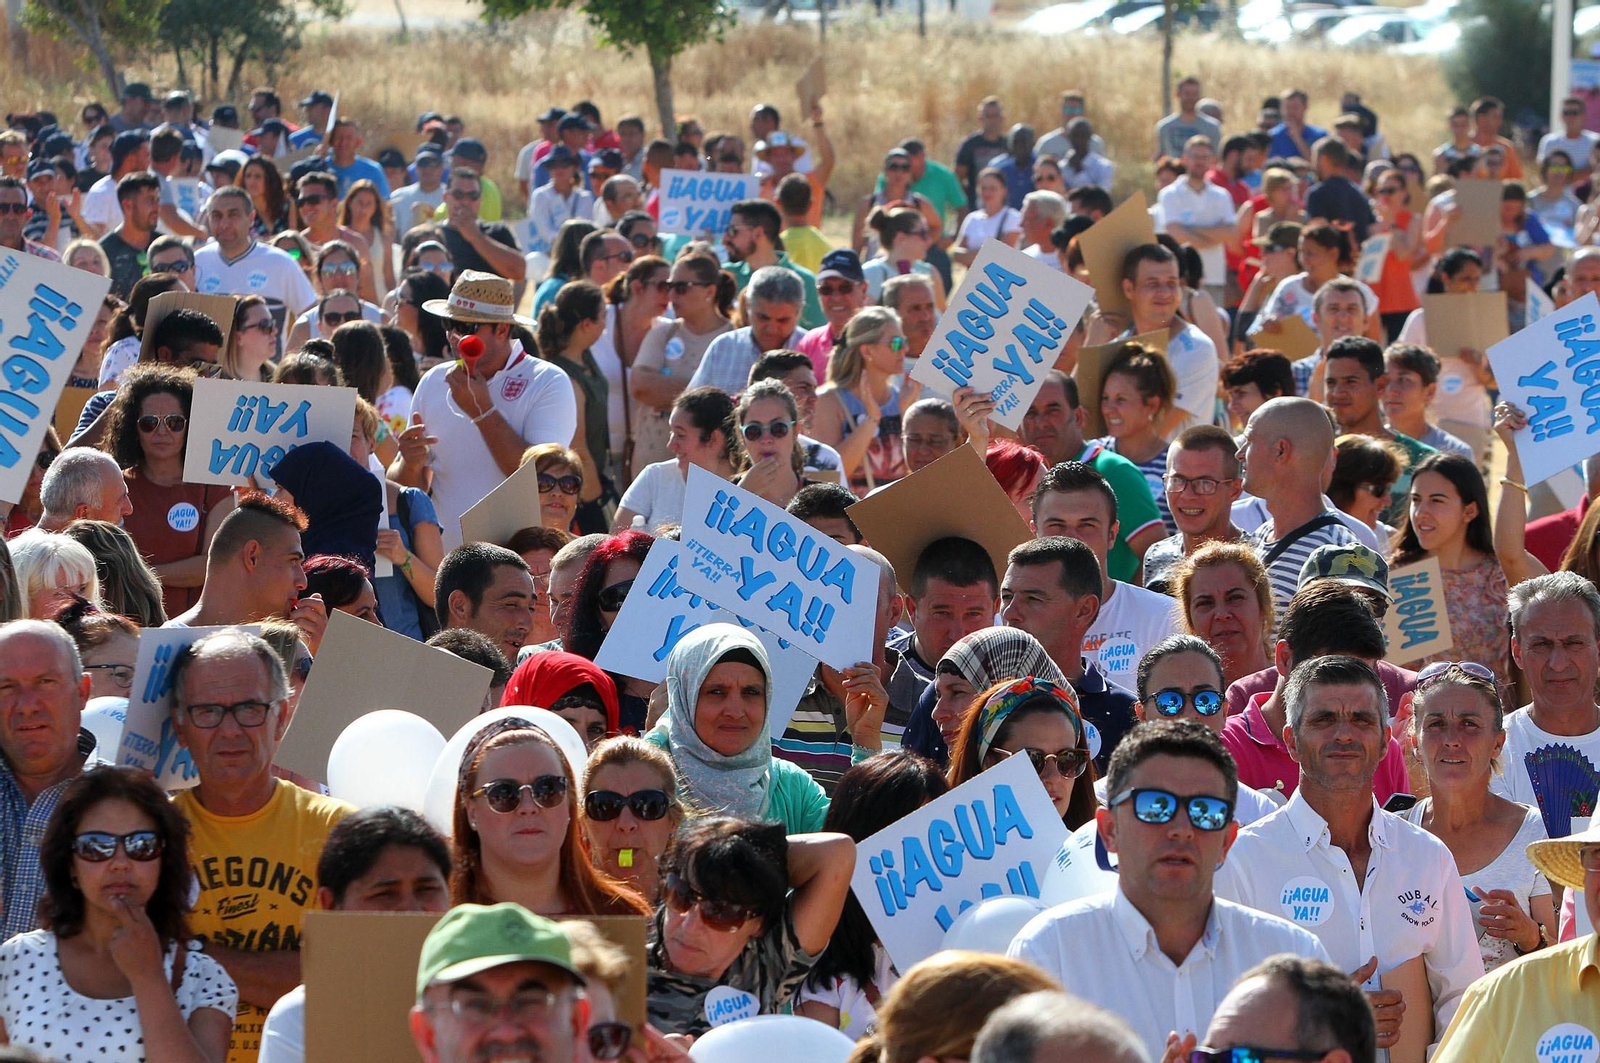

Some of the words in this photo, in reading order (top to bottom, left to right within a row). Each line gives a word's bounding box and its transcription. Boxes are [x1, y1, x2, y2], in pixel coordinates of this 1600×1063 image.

[931, 262, 1027, 387] ¡¡AGUA
[992, 298, 1067, 385] YA!!
[988, 374, 1018, 403] ERRA
[1554, 314, 1600, 435] ¡¡AG
[995, 393, 1021, 416] YA!!
[1517, 360, 1575, 442] YA!!
[227, 394, 312, 438] YA!!
[168, 508, 196, 521] ¡¡AGUA
[175, 518, 192, 528] YA!!
[685, 538, 743, 584] ¡¡TIERRA
[704, 489, 857, 605] ¡¡AGUA
[691, 557, 723, 585] YA!!
[736, 555, 836, 644] YA!!
[1389, 571, 1440, 650] ¡¡AGUA
[1099, 643, 1136, 661] ¡¡AGUA
[1108, 658, 1130, 672] YA!!
[869, 784, 1034, 916] ¡¡AGUA
[1282, 887, 1329, 905] ¡¡AGUA
[1397, 889, 1438, 909] DUBAI
[1293, 905, 1321, 922] YA!!
[1400, 912, 1420, 927] SNOW
[1421, 916, 1435, 928] POLO
[707, 993, 752, 1022] ¡¡AGUA
[1538, 1034, 1594, 1056] ¡¡AGUA
